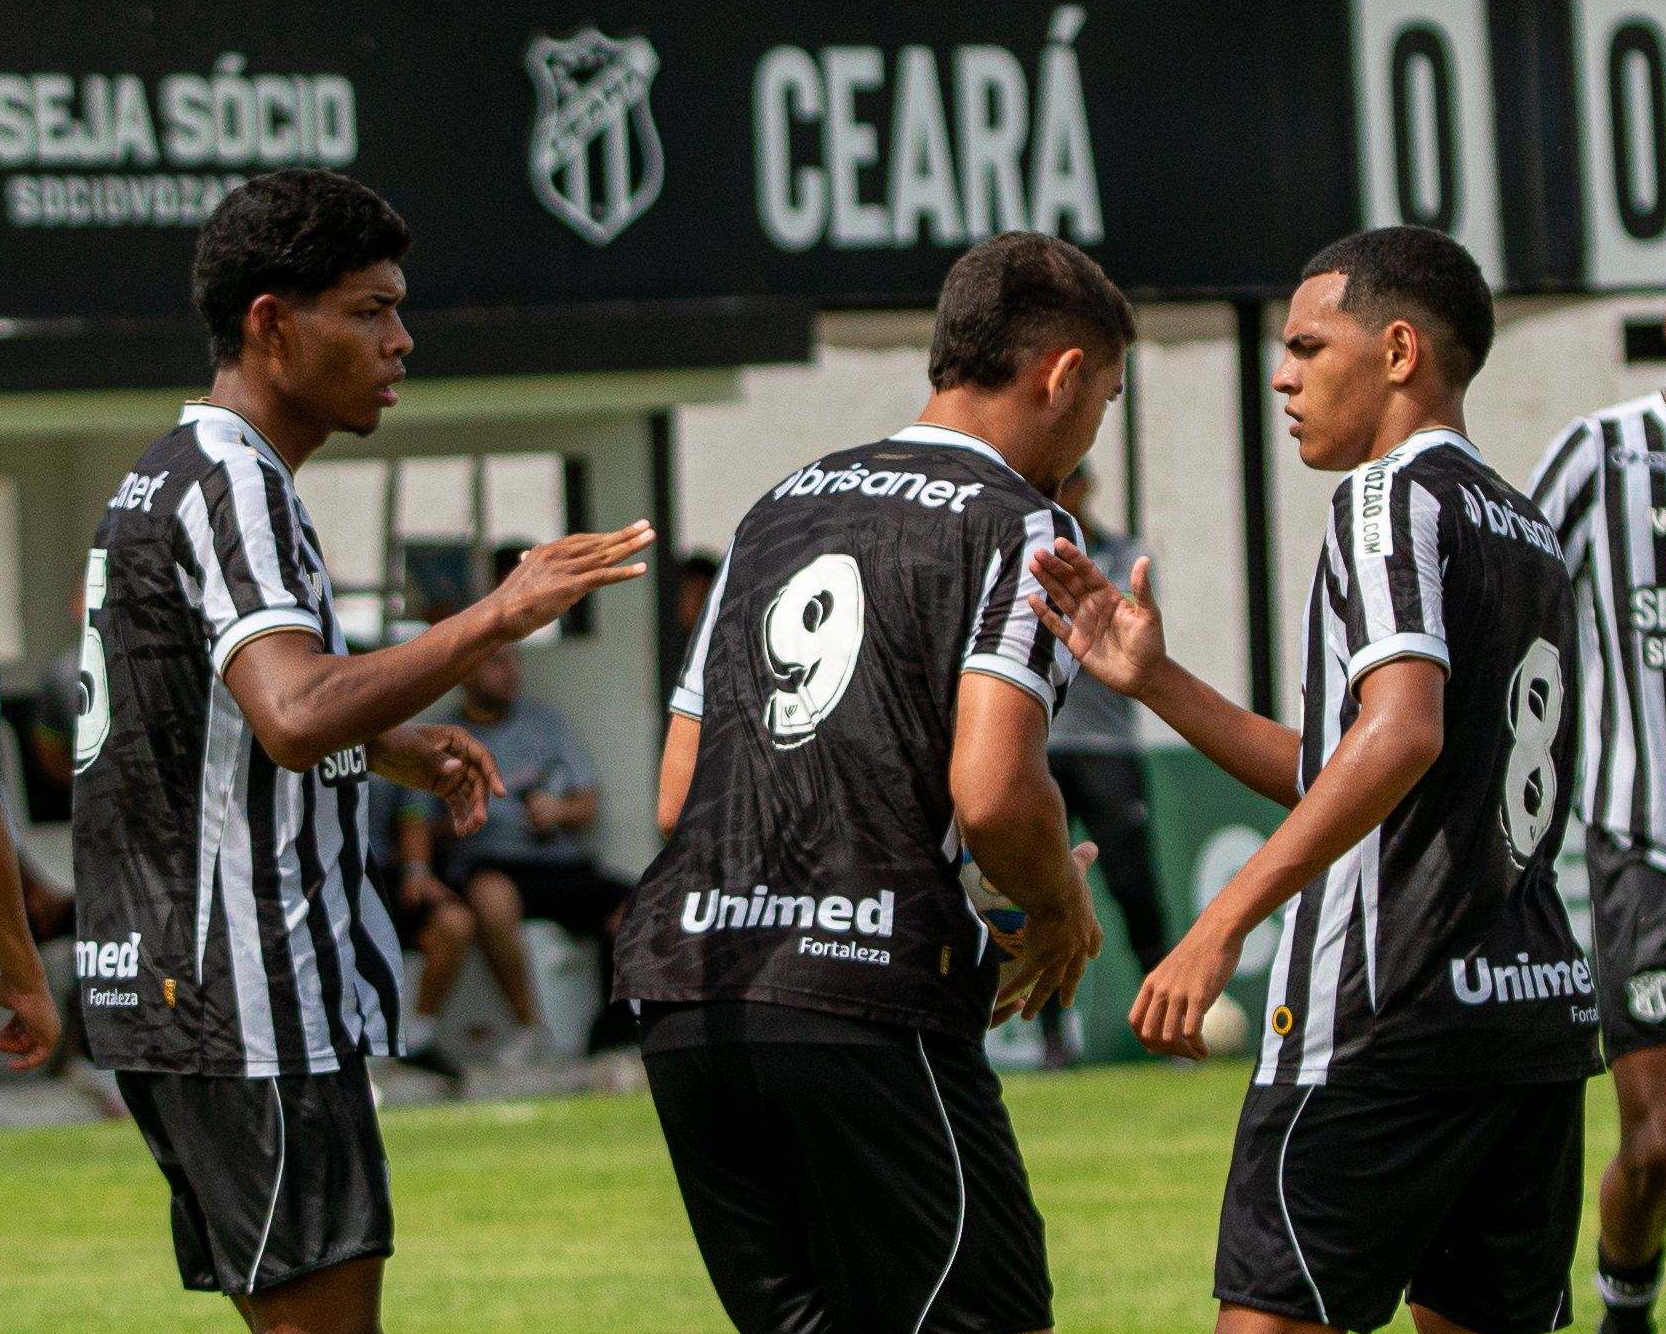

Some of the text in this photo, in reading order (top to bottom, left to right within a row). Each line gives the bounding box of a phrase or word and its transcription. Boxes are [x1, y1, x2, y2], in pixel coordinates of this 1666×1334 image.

[159, 51, 358, 166] SÓCIO
[751, 4, 1105, 251] CEARÁ
[1390, 18, 1459, 230] 0
[4, 174, 250, 228] SOCIOVOZA
[792, 462, 984, 513] brisanet
[764, 553, 865, 750] 9
[1499, 636, 1564, 870] 8
[682, 885, 895, 937] Unimed
[798, 937, 891, 965] Fortaleza
[89, 988, 139, 1007] Fortaleza
[1450, 952, 1594, 1005] Unime
